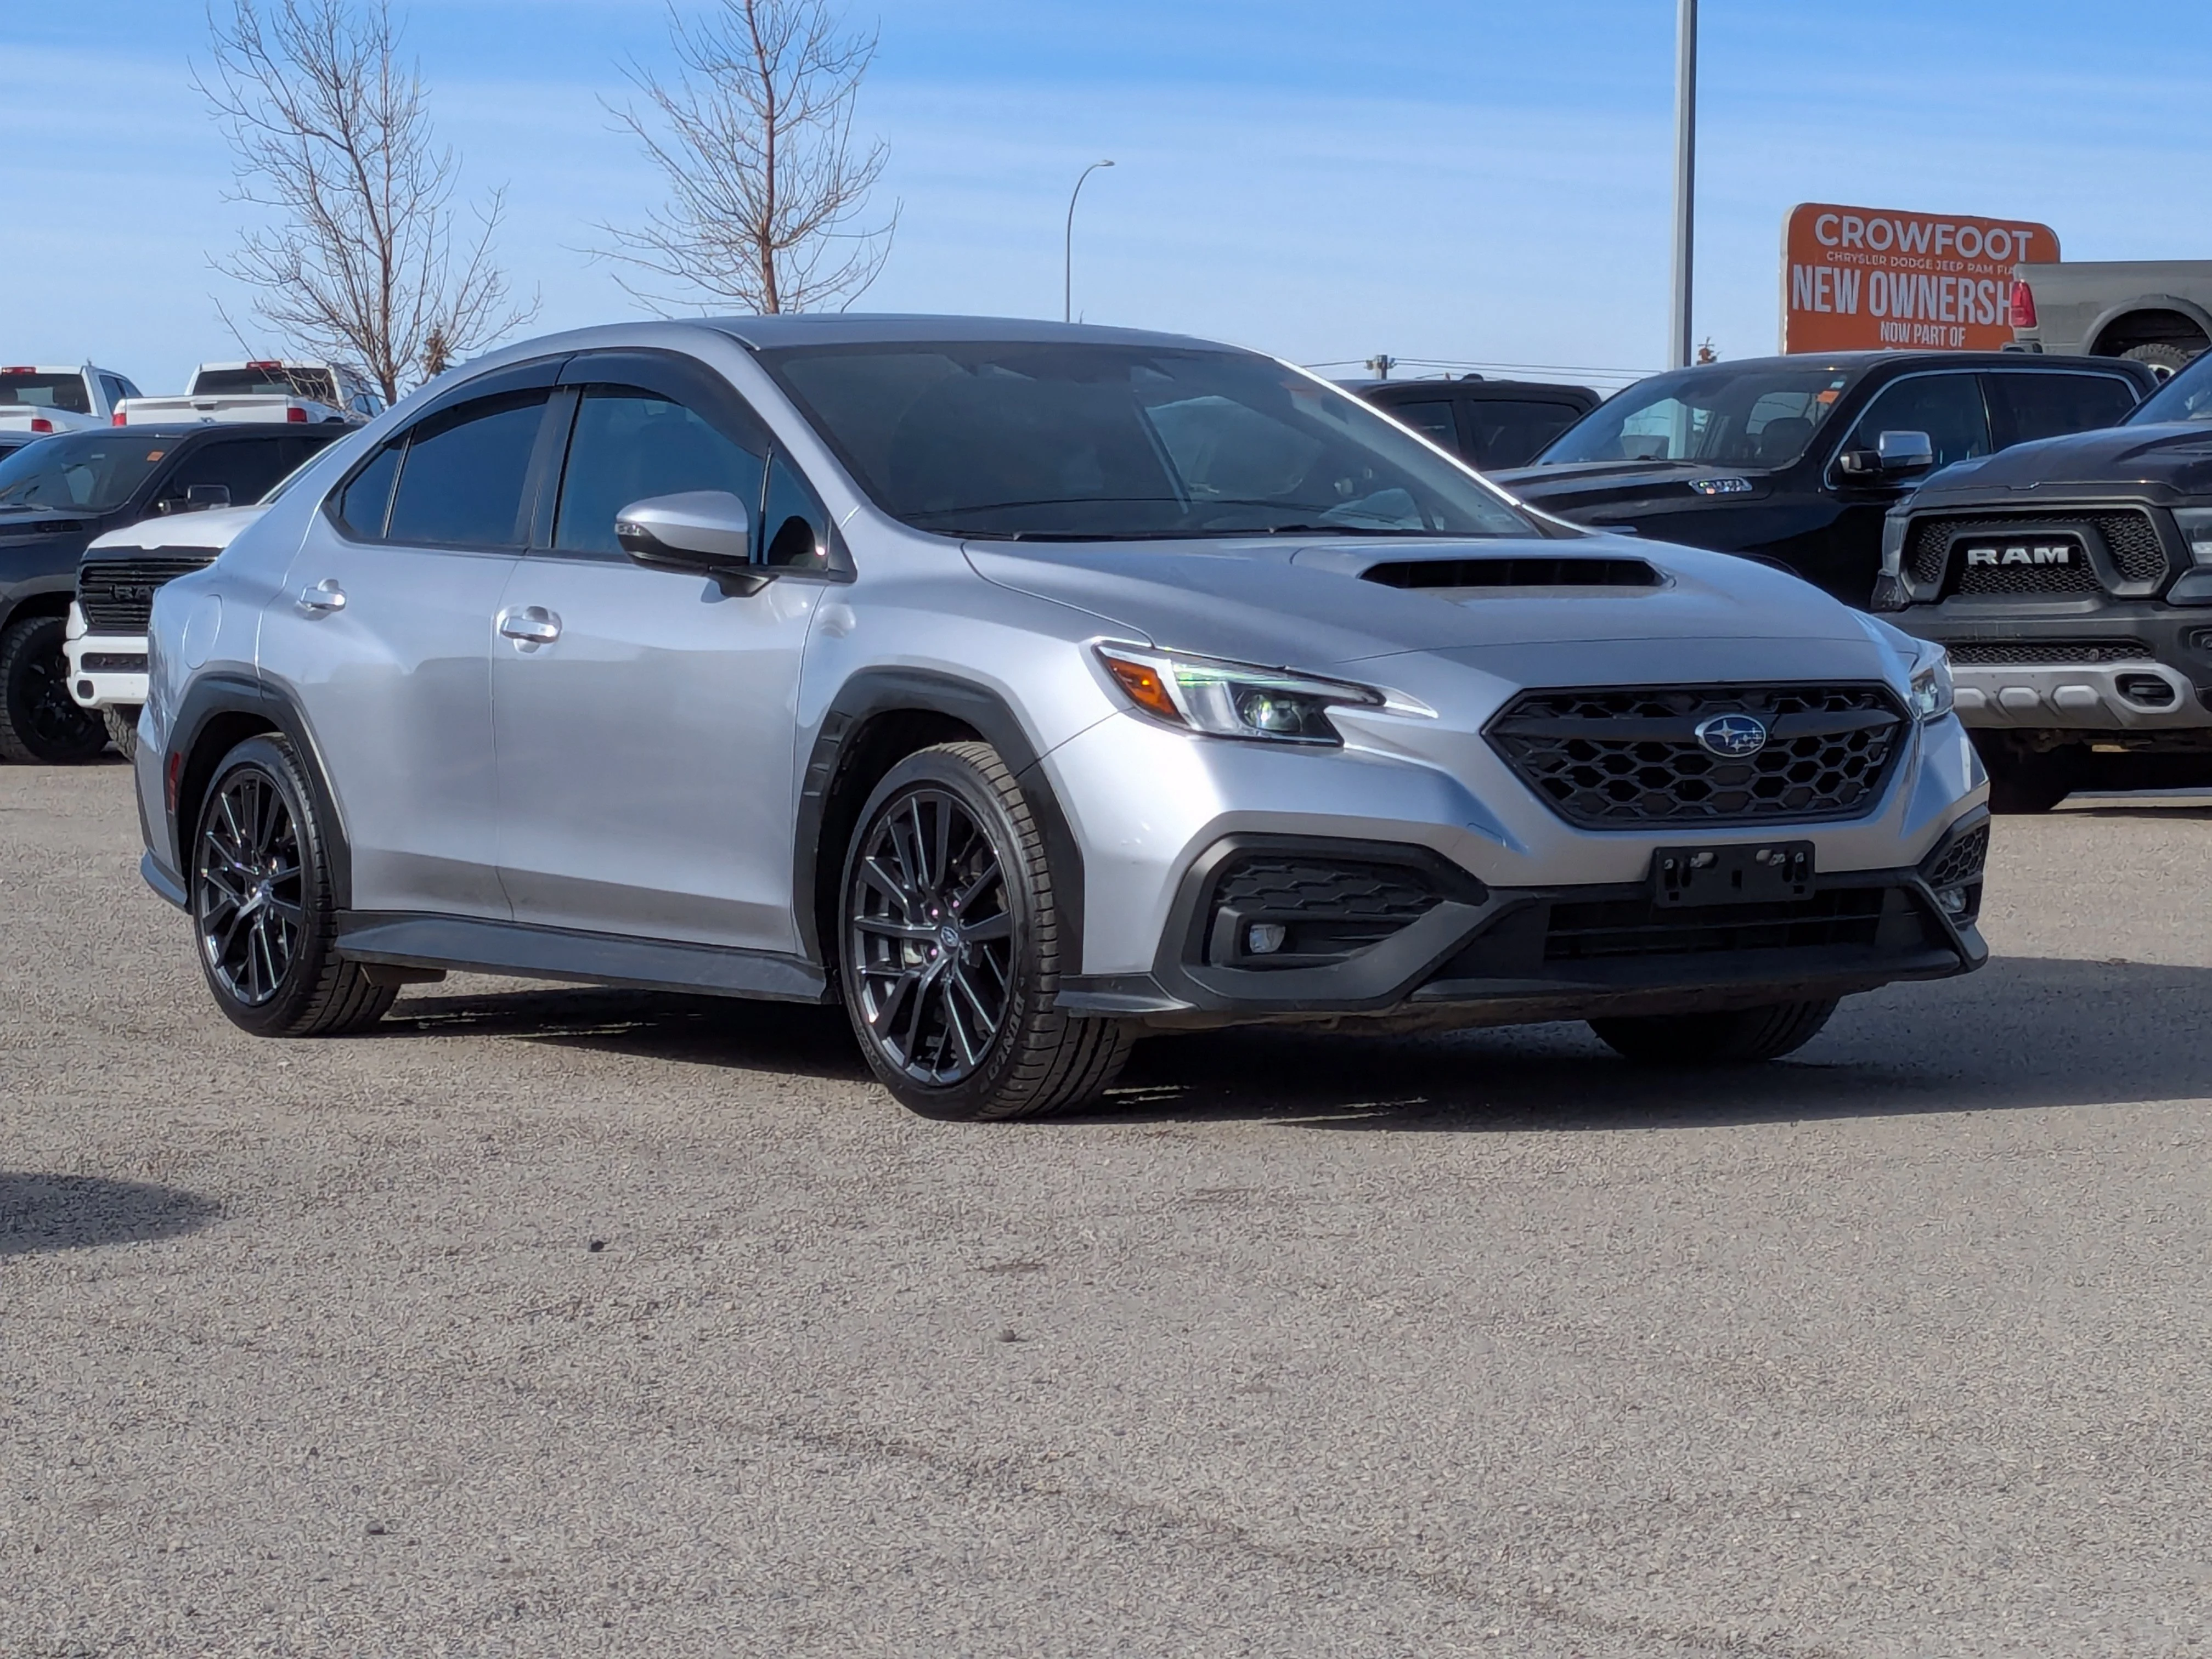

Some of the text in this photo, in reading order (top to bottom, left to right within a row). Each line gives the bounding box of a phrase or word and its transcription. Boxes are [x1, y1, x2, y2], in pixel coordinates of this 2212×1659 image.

[1815, 213, 2033, 262] CROWFOOT
[1826, 250, 1887, 266] CHRYSLER
[1891, 256, 1933, 270] DODGE
[1936, 259, 1963, 272] JEEP
[1967, 264, 1993, 275] RAM
[1792, 264, 1860, 314] NEW
[1880, 321, 1966, 347] NOW PART OF
[1967, 547, 2068, 565] RAM
